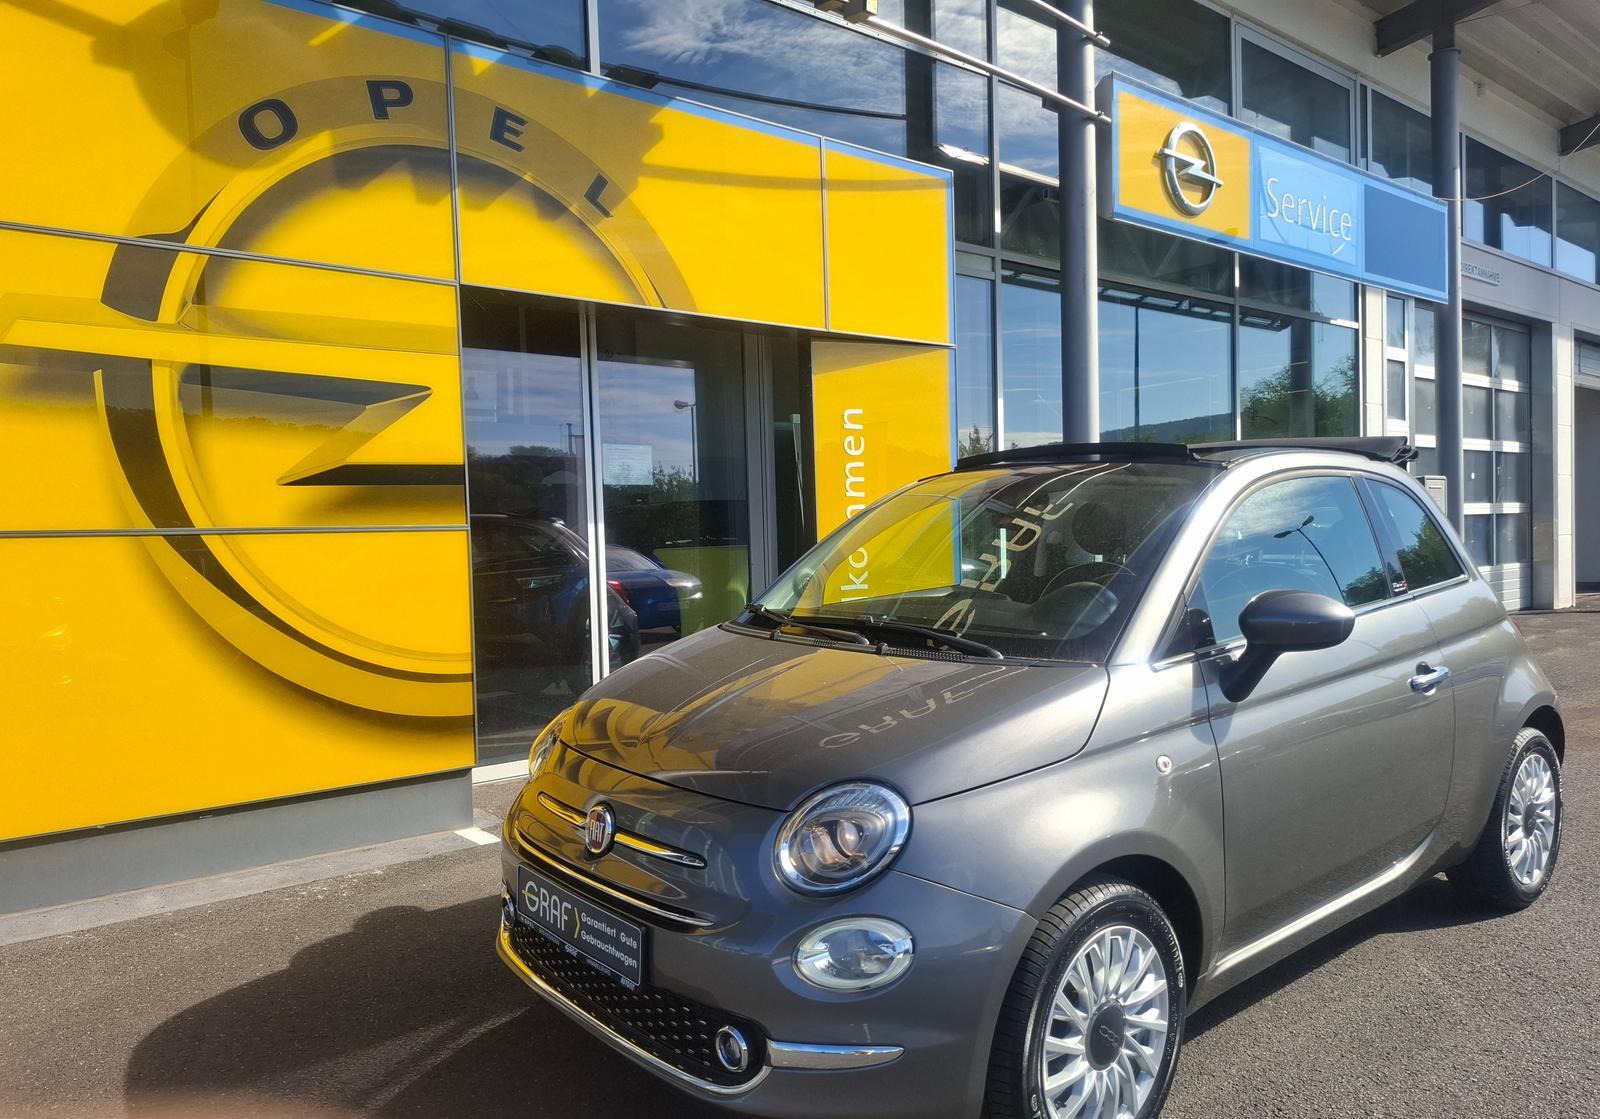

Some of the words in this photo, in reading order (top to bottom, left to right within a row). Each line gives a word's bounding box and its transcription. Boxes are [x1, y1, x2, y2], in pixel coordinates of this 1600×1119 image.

[238, 79, 614, 219] OPEL
[1266, 176, 1352, 241] Service
[589, 819, 605, 843] FIAT
[521, 880, 572, 932] GRAF
[580, 930, 638, 969] Gebrauchtwagen
[581, 911, 617, 938] Garantiert
[620, 931, 638, 950] Gute
